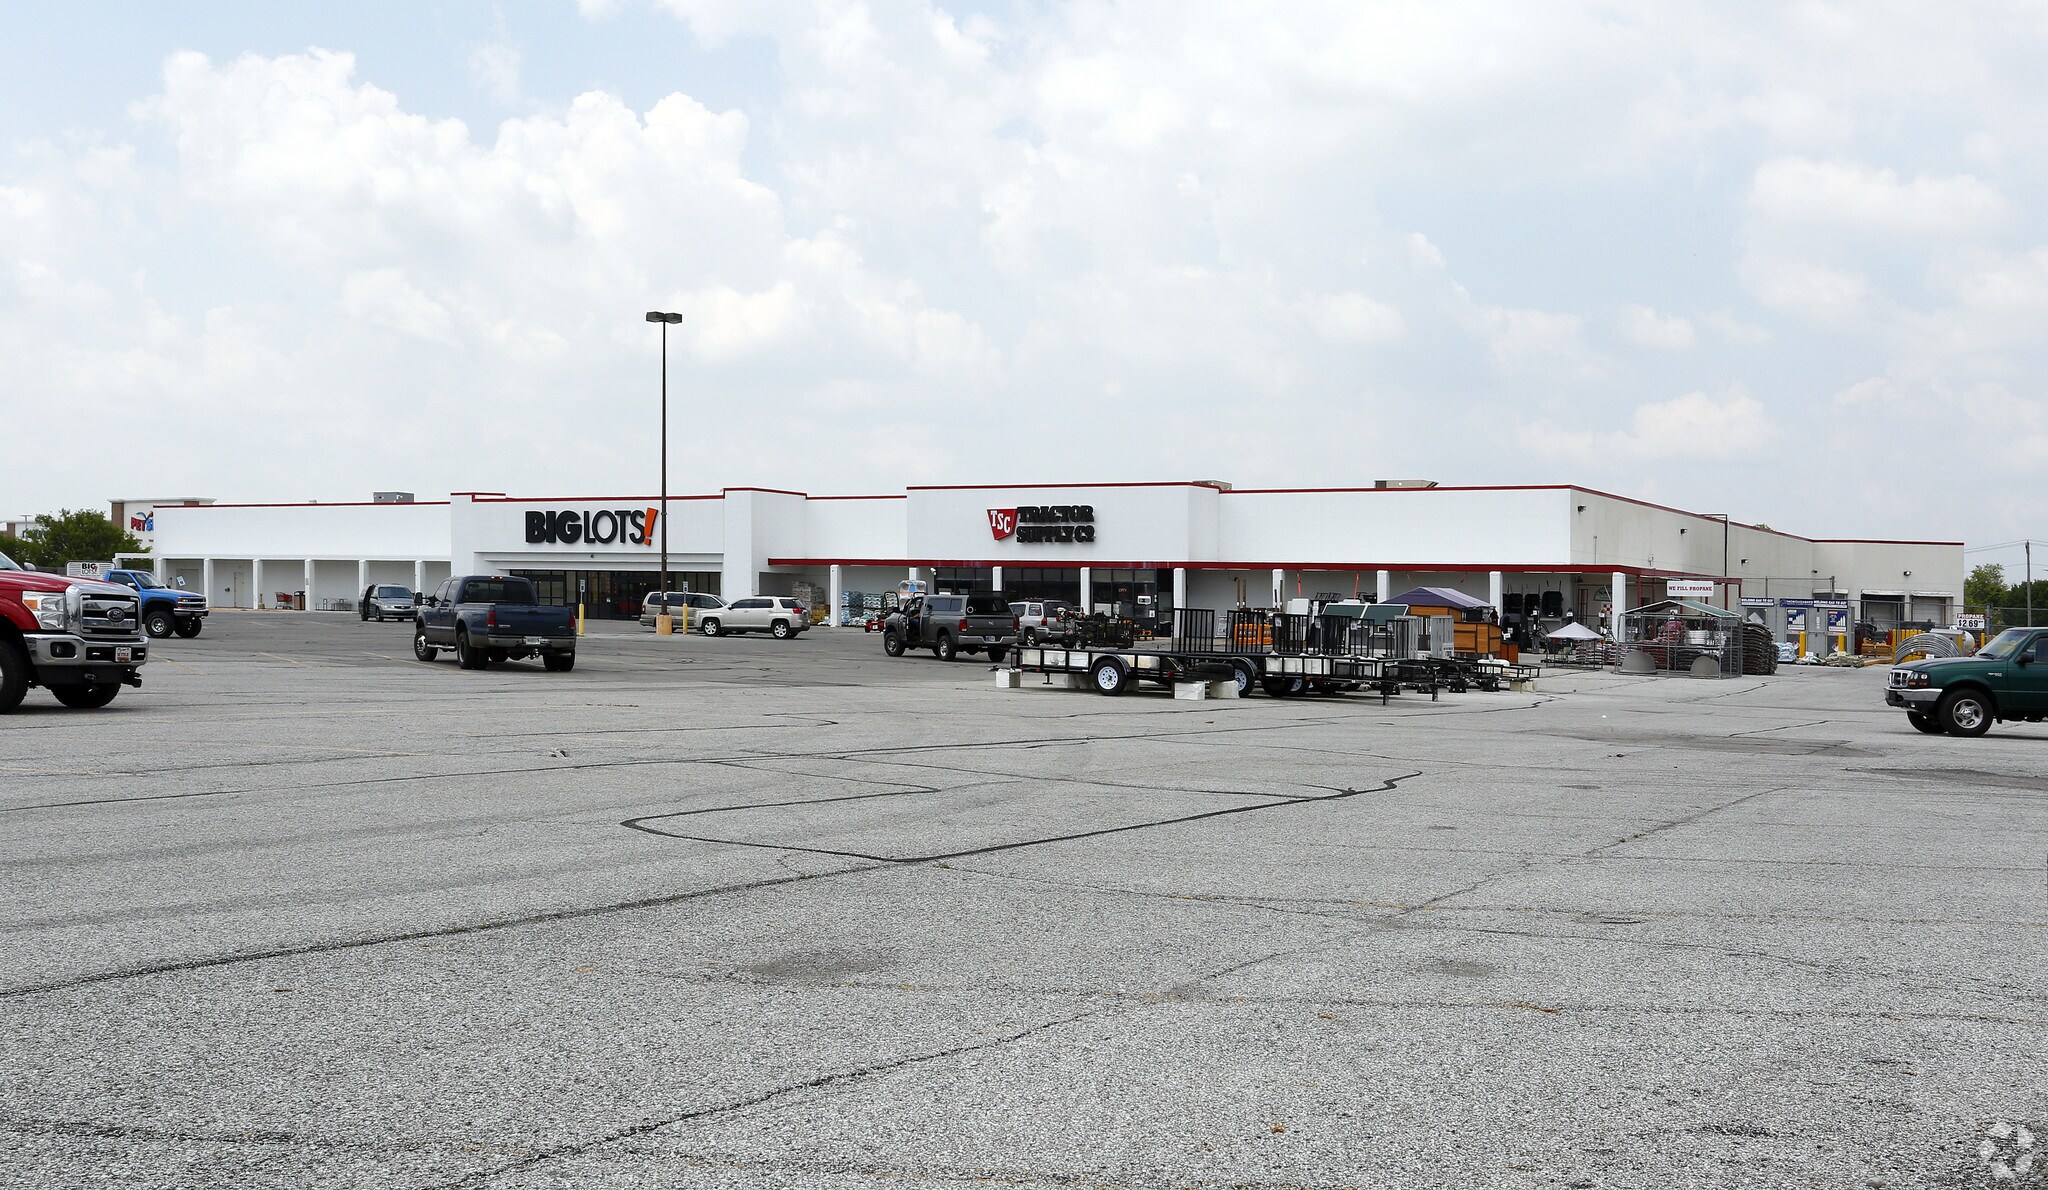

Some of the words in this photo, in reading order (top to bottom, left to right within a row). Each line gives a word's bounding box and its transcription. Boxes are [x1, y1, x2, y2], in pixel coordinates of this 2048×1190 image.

[990, 510, 1011, 534] TSC
[1017, 505, 1095, 522] TRACTOR
[131, 516, 154, 531] PETS
[1016, 526, 1074, 543] SUPPLY
